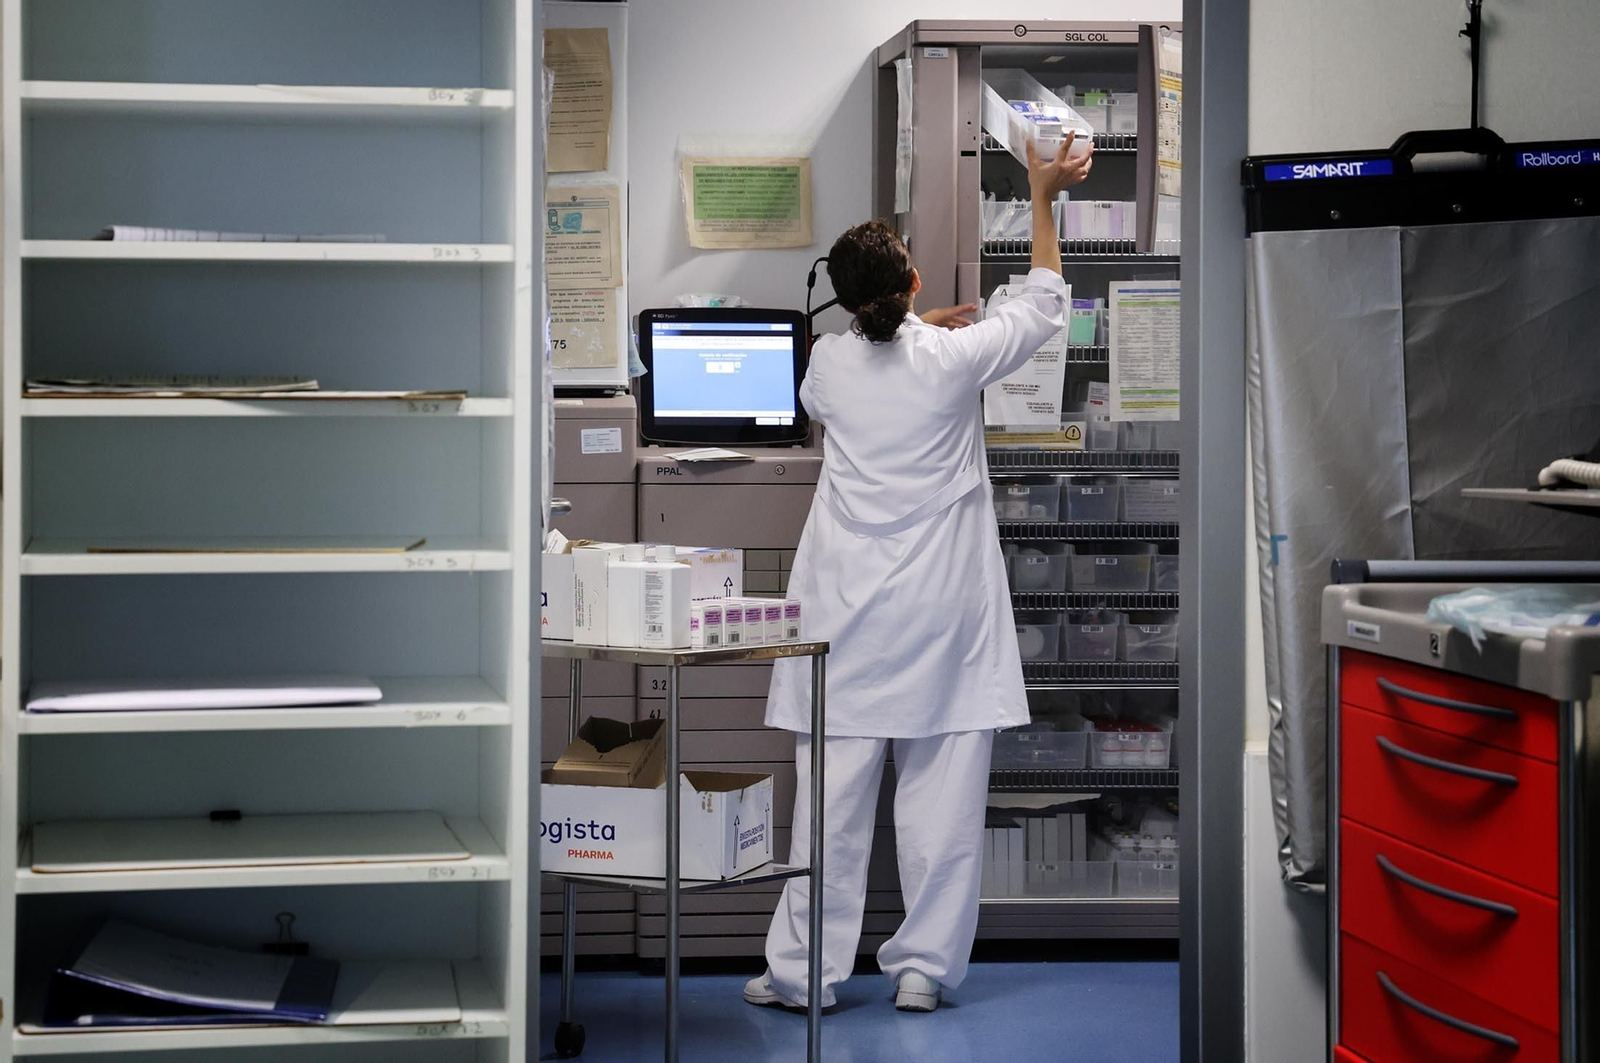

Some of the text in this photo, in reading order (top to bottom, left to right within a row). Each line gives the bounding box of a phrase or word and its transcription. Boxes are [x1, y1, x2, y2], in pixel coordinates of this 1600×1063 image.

[1065, 33, 1109, 41] SGL COL
[1522, 151, 1600, 166] Rollbord H
[1293, 162, 1364, 179] SAMARIT
[550, 339, 567, 350] 75
[656, 467, 683, 476] PPAL
[652, 679, 667, 690] 3.2
[567, 849, 614, 859] PHARMA
